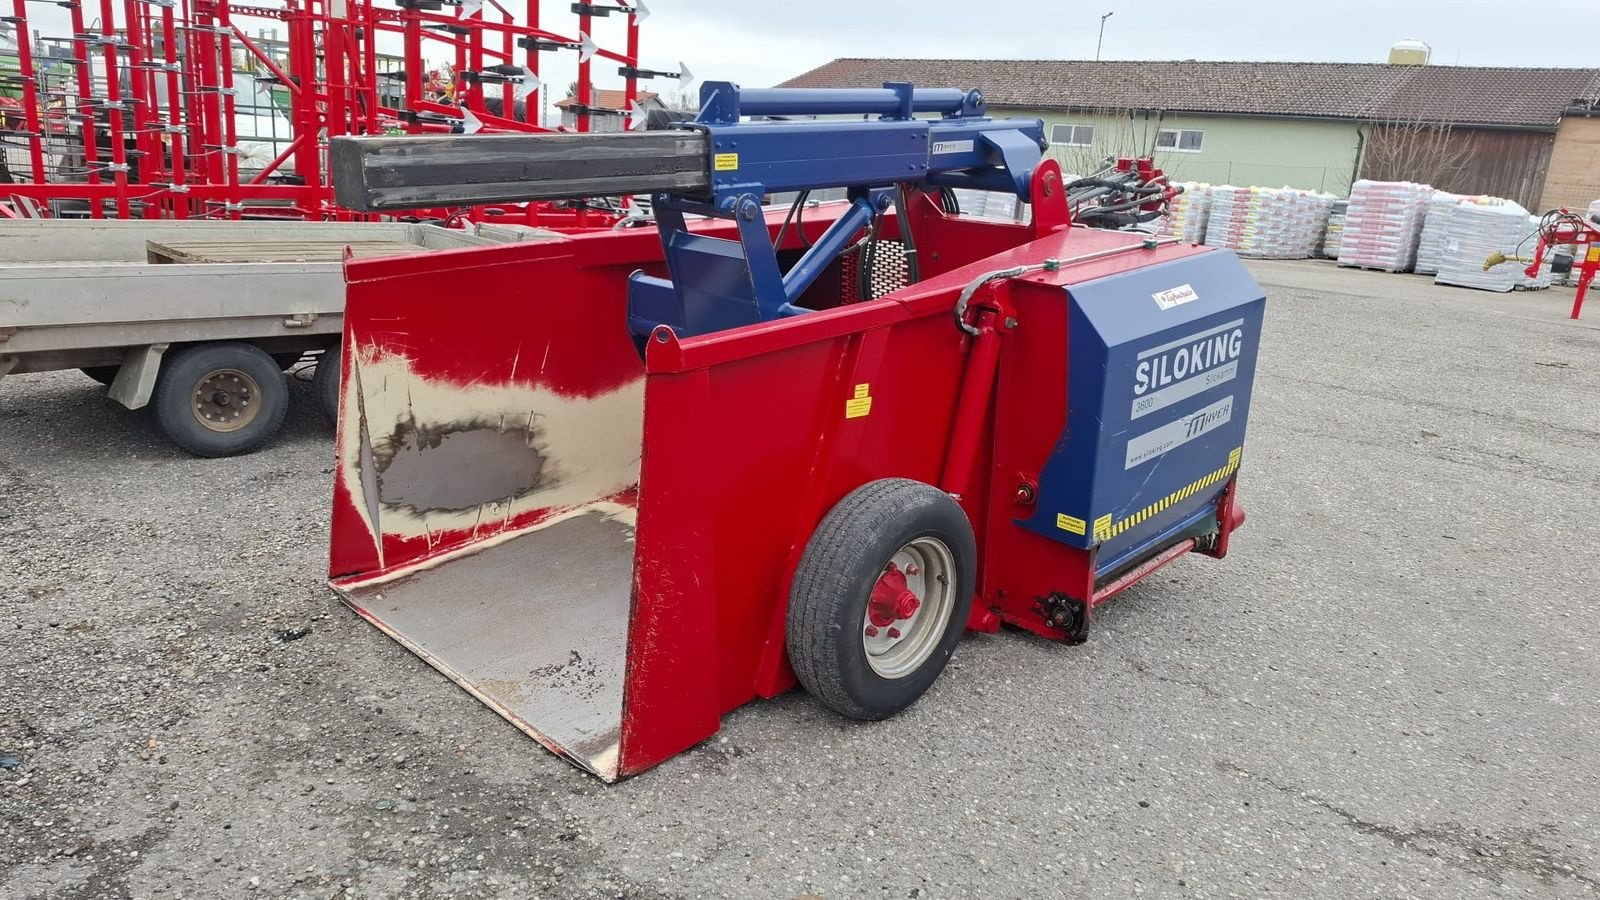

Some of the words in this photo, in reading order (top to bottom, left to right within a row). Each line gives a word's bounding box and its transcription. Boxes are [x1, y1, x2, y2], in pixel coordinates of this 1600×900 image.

[1134, 329, 1243, 395] SILOKING
[1136, 397, 1154, 413] 3600
[1130, 440, 1174, 463] www.siloking.com
